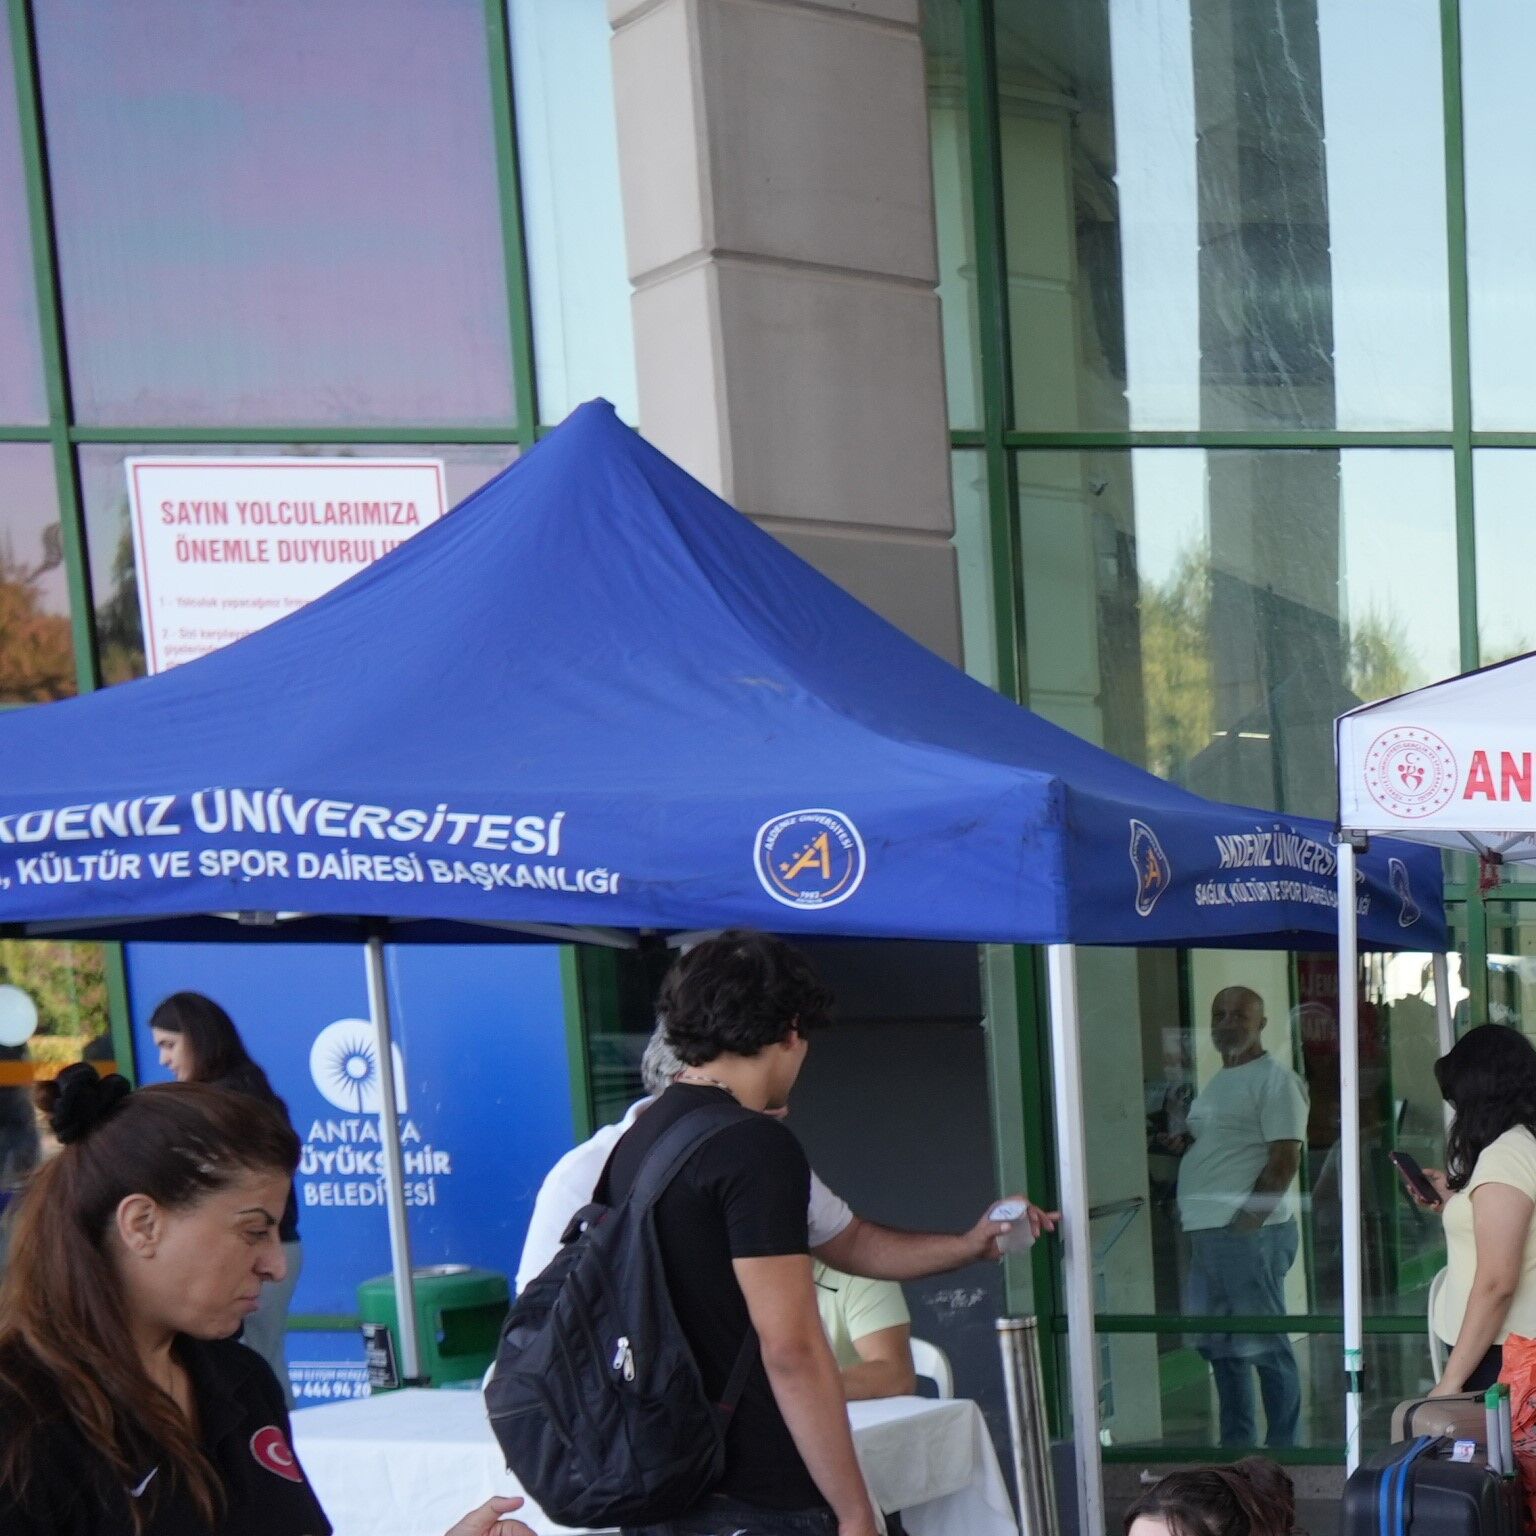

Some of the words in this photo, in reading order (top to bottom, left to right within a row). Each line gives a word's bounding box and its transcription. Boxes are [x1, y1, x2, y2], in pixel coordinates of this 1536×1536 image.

[160, 501, 229, 525] SAYIN
[238, 501, 420, 526] YOLCULARIMIZA
[175, 534, 270, 563] ÖNEMLE
[191, 786, 566, 857] ÜNİVERSİTESİ
[1215, 826, 1272, 868] AKDENİZ
[16, 849, 141, 885] KÜLTÜR
[149, 851, 192, 879] VE
[199, 850, 289, 880] SPOR
[298, 848, 424, 883] DAİRESİ
[426, 858, 620, 895] BAŞKANLIĞI
[307, 1120, 421, 1143] ANTAA
[304, 1177, 436, 1206] BELEDİESİ
